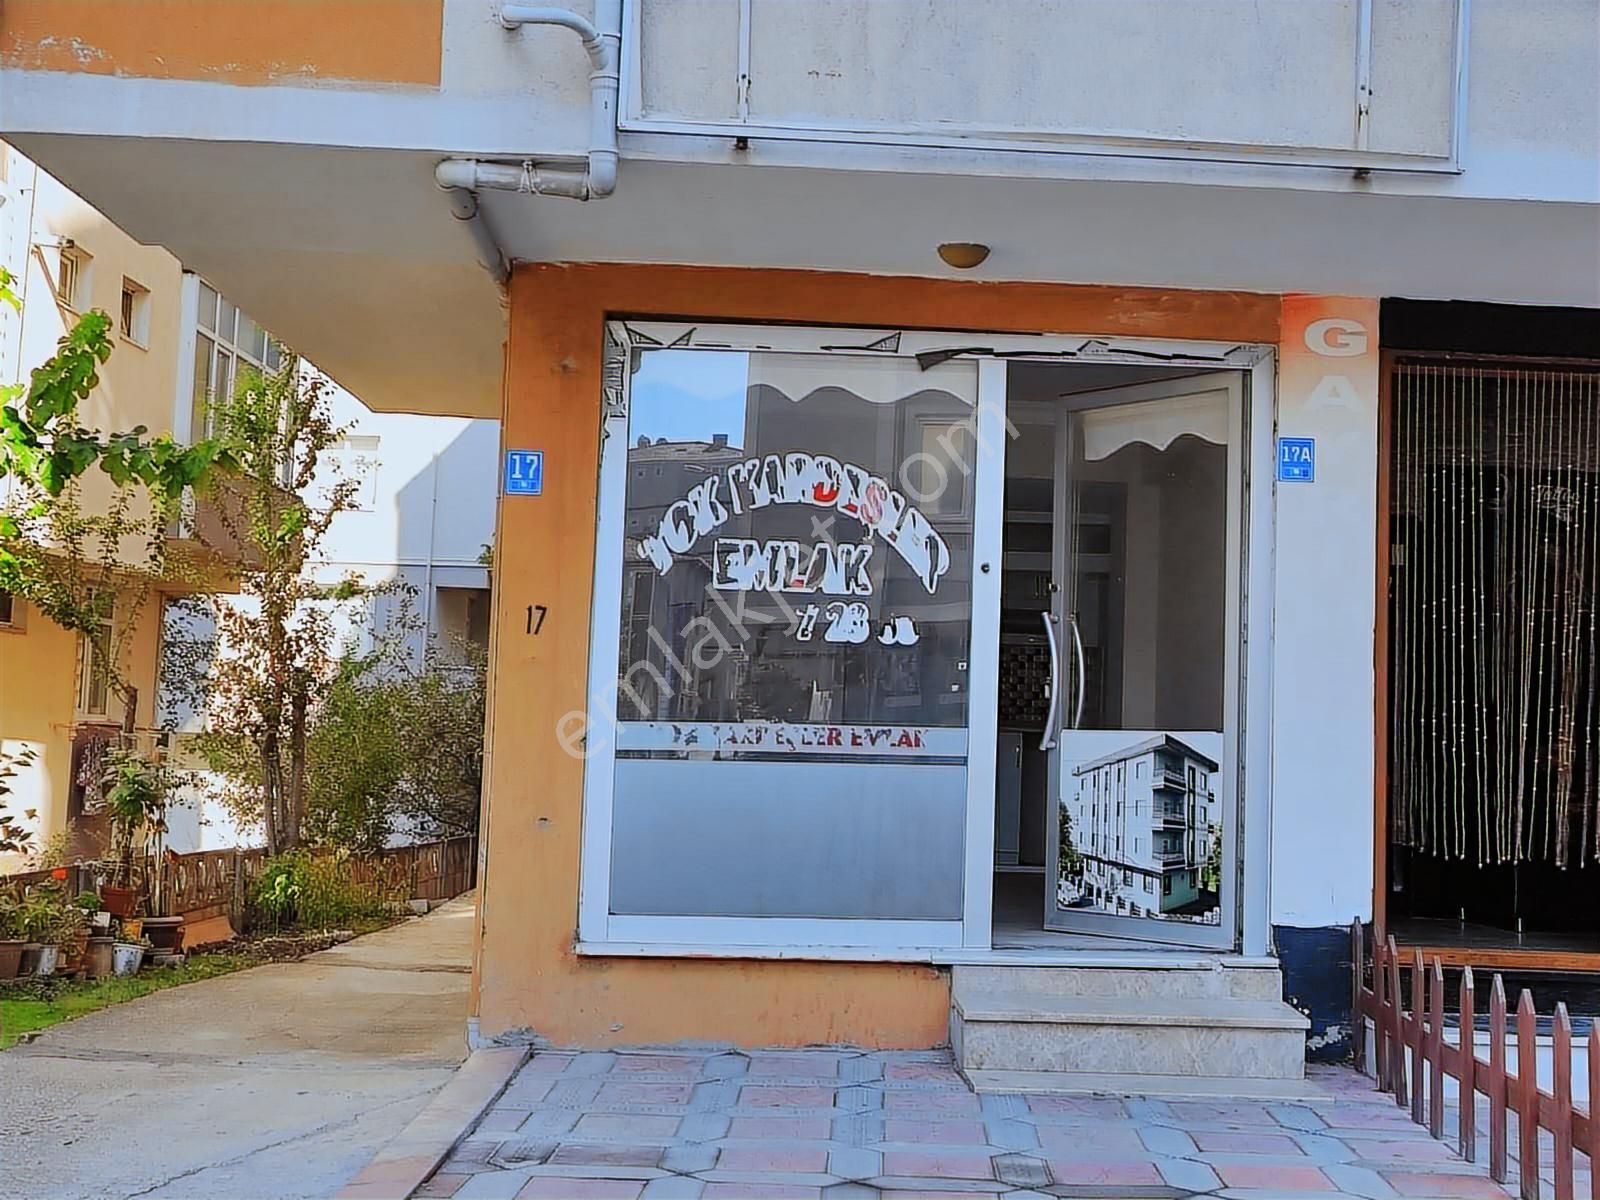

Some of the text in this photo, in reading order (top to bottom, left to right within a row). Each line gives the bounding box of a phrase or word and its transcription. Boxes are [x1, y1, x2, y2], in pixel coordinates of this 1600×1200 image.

[511, 454, 538, 480] 17
[1283, 446, 1312, 463] 17A
[526, 605, 547, 635] 17
